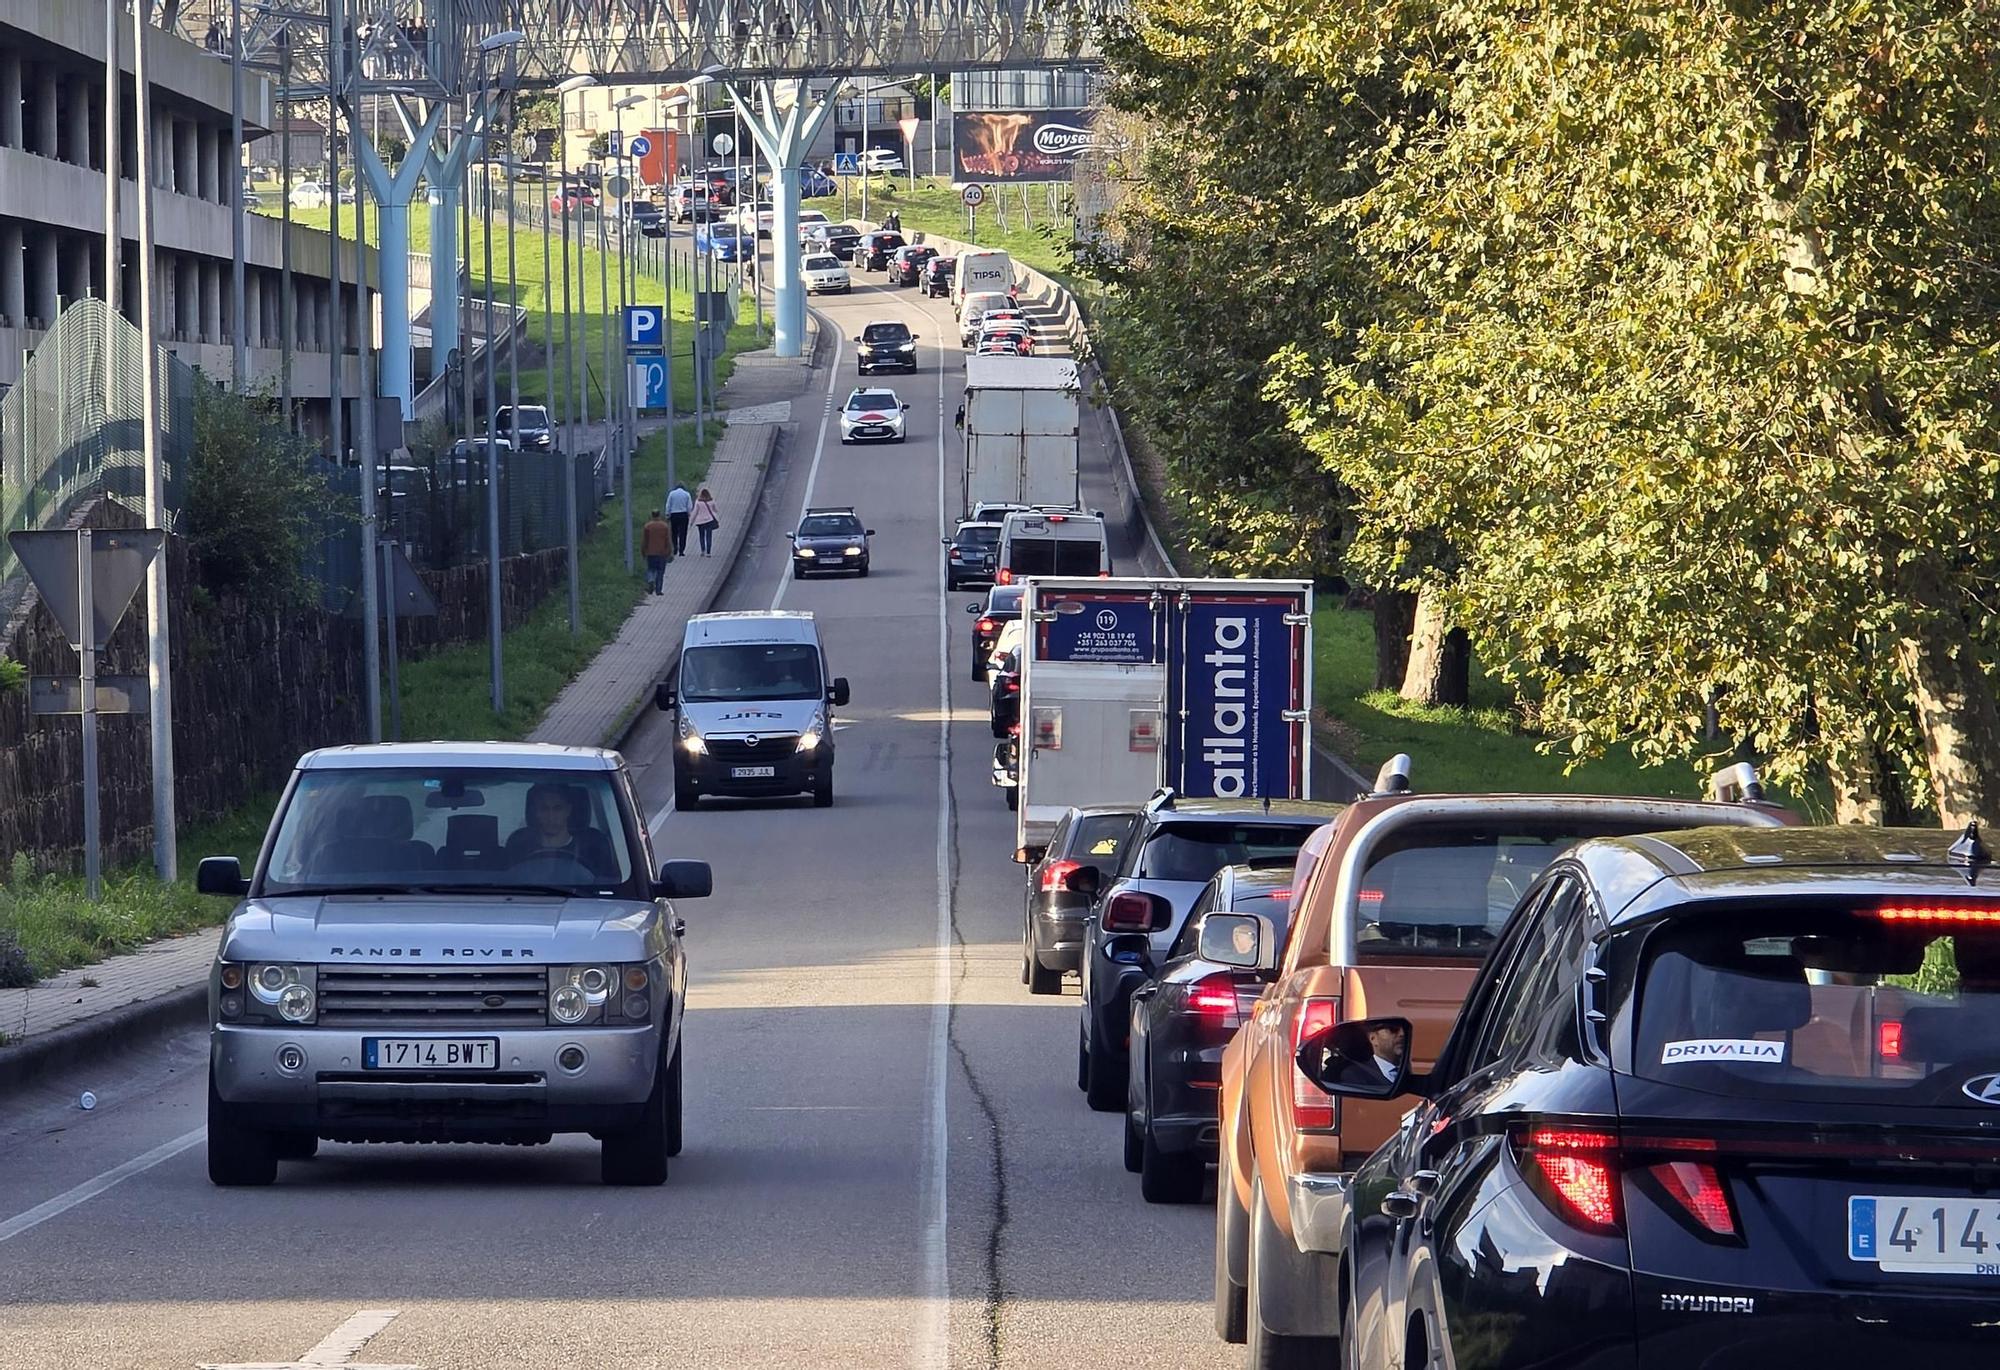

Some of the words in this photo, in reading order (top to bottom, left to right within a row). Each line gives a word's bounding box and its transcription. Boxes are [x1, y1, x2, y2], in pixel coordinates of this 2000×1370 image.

[966, 191, 980, 199] 40
[973, 271, 1001, 279] TIPSA
[631, 310, 656, 341] P
[1099, 616, 1114, 624] 119
[1203, 618, 1247, 798] atlanta
[331, 948, 422, 956] RANGE
[442, 949, 534, 957] ROVER
[384, 1044, 437, 1064] 1714
[447, 1044, 489, 1064] BWT
[1666, 1044, 1778, 1058] DRIVALIA
[1858, 1234, 1869, 1248] E
[1976, 1264, 2000, 1274] DRI
[1661, 1294, 1754, 1313] HYUNDAI
